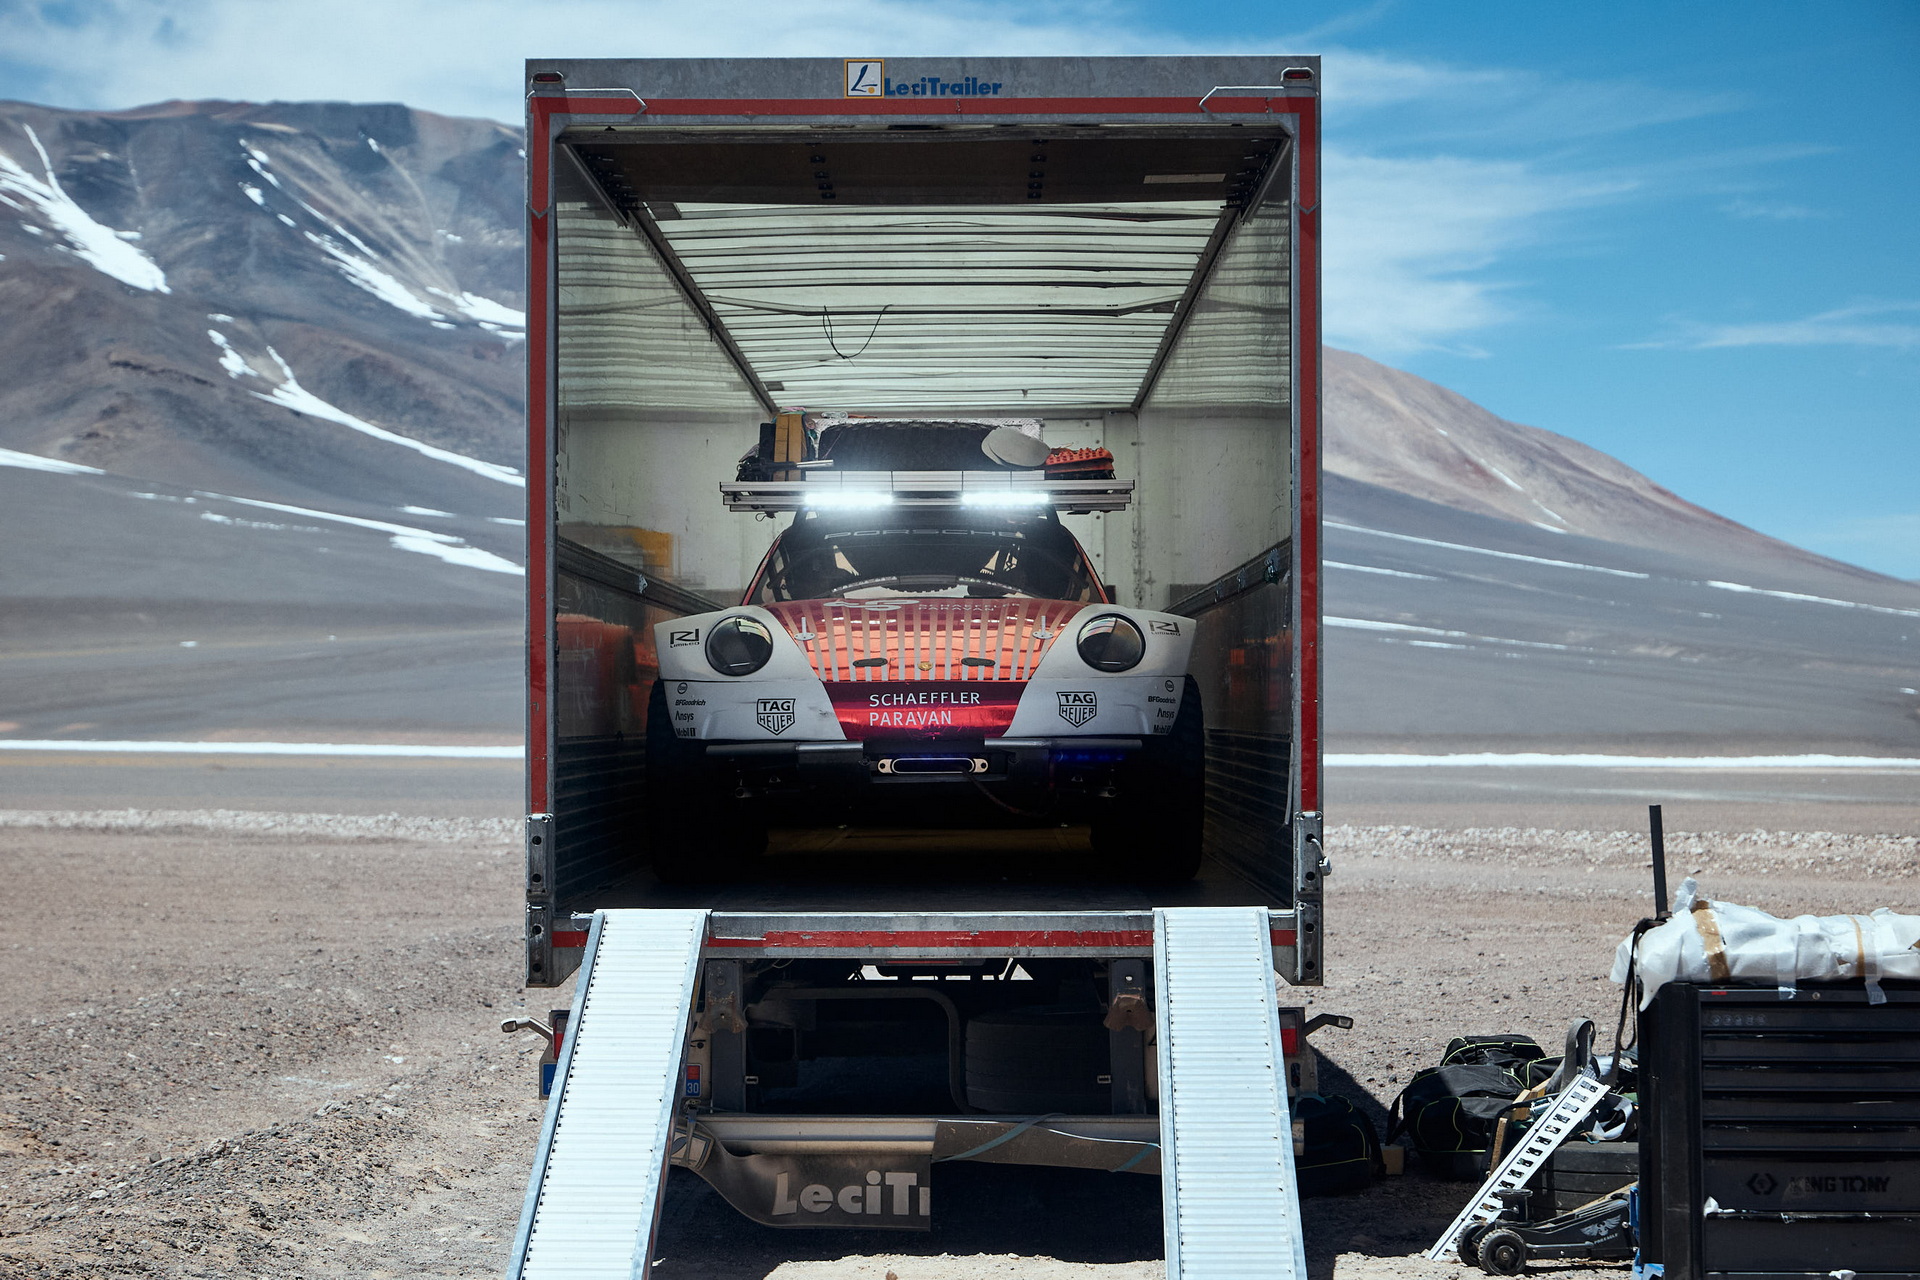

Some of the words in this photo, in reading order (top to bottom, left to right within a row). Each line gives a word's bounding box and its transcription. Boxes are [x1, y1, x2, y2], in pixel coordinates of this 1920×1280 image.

[884, 77, 1002, 96] LeciTrailer
[824, 529, 1026, 539] PORSCHE
[869, 692, 981, 707] SCHAEFFLER
[1061, 693, 1094, 704] TAG
[1148, 695, 1177, 704] BFGoodrich
[760, 701, 791, 711] TAG
[675, 710, 694, 722] Ansys
[869, 710, 952, 726] PARAVAN
[1062, 707, 1095, 724] HEUER
[1157, 707, 1175, 721] Ansys
[759, 715, 792, 732] HEUER
[687, 1082, 699, 1094] 30
[1839, 1176, 1890, 1192] TONY
